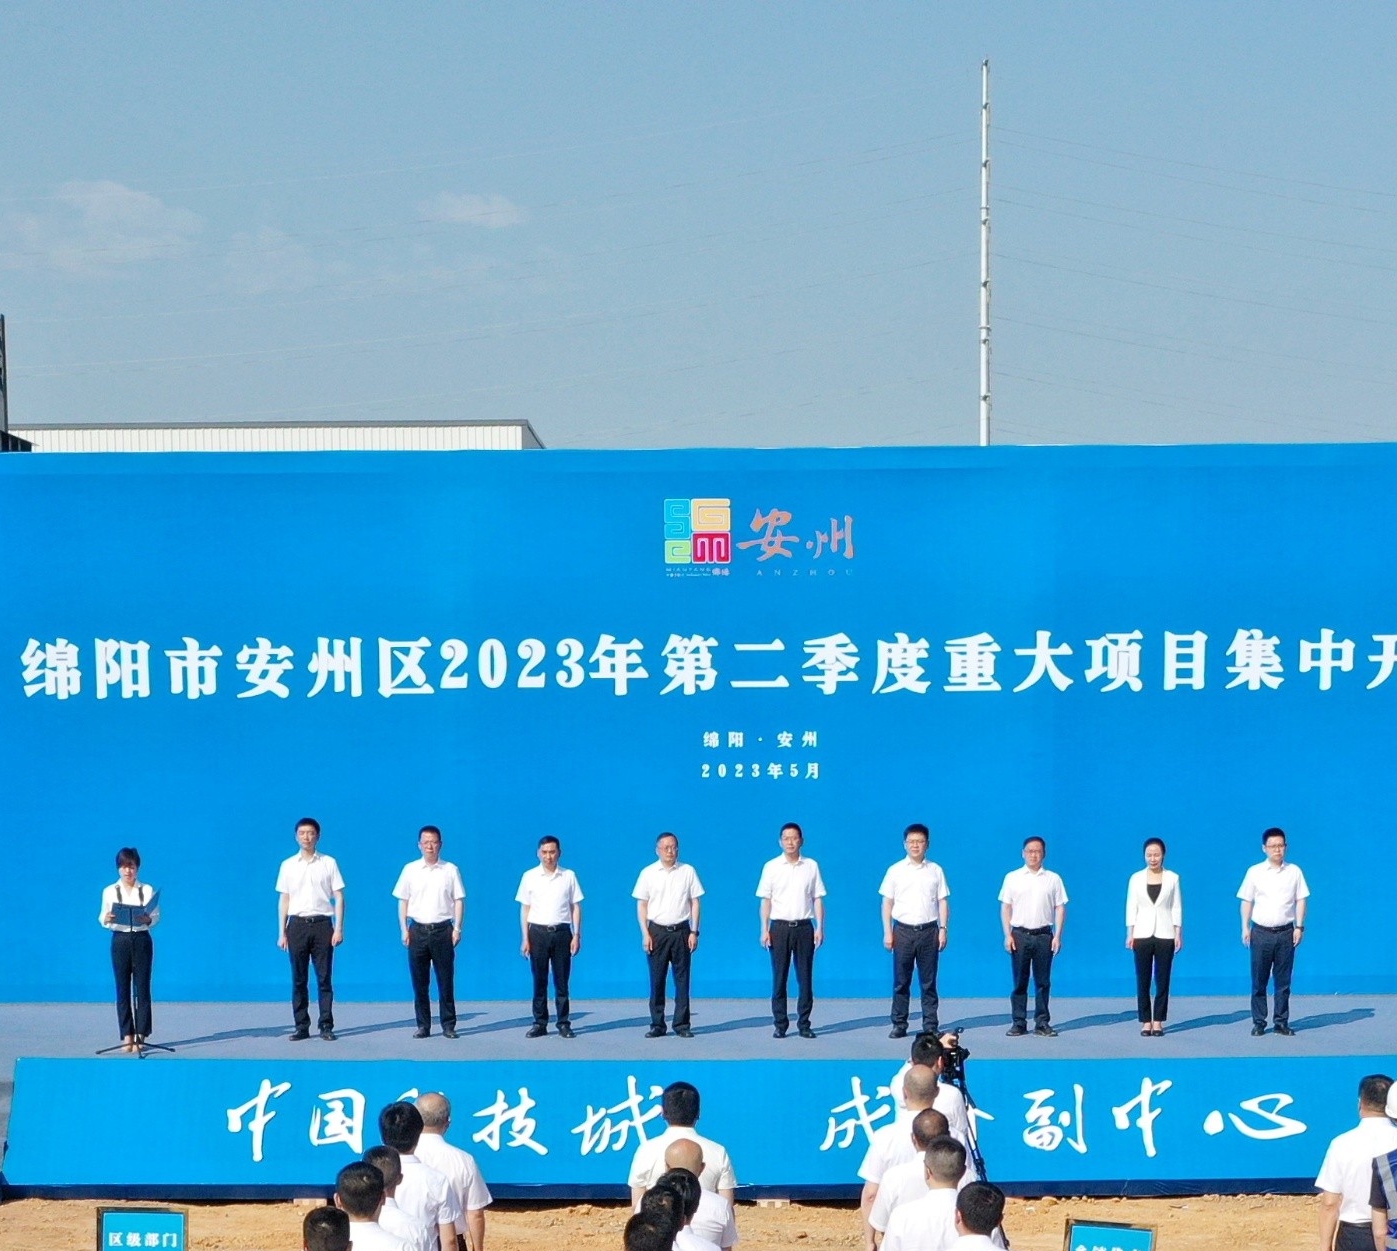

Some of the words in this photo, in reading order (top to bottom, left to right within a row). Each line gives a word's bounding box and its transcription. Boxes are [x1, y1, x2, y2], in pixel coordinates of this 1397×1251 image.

[736, 508, 854, 562] 安州
[756, 569, 853, 577] ANZHOU
[701, 762, 819, 779] 2023年5月
[227, 1075, 663, 1162] 中国技城
[819, 1076, 1308, 1157] 成副中心
[108, 1231, 178, 1248] 区级部门
